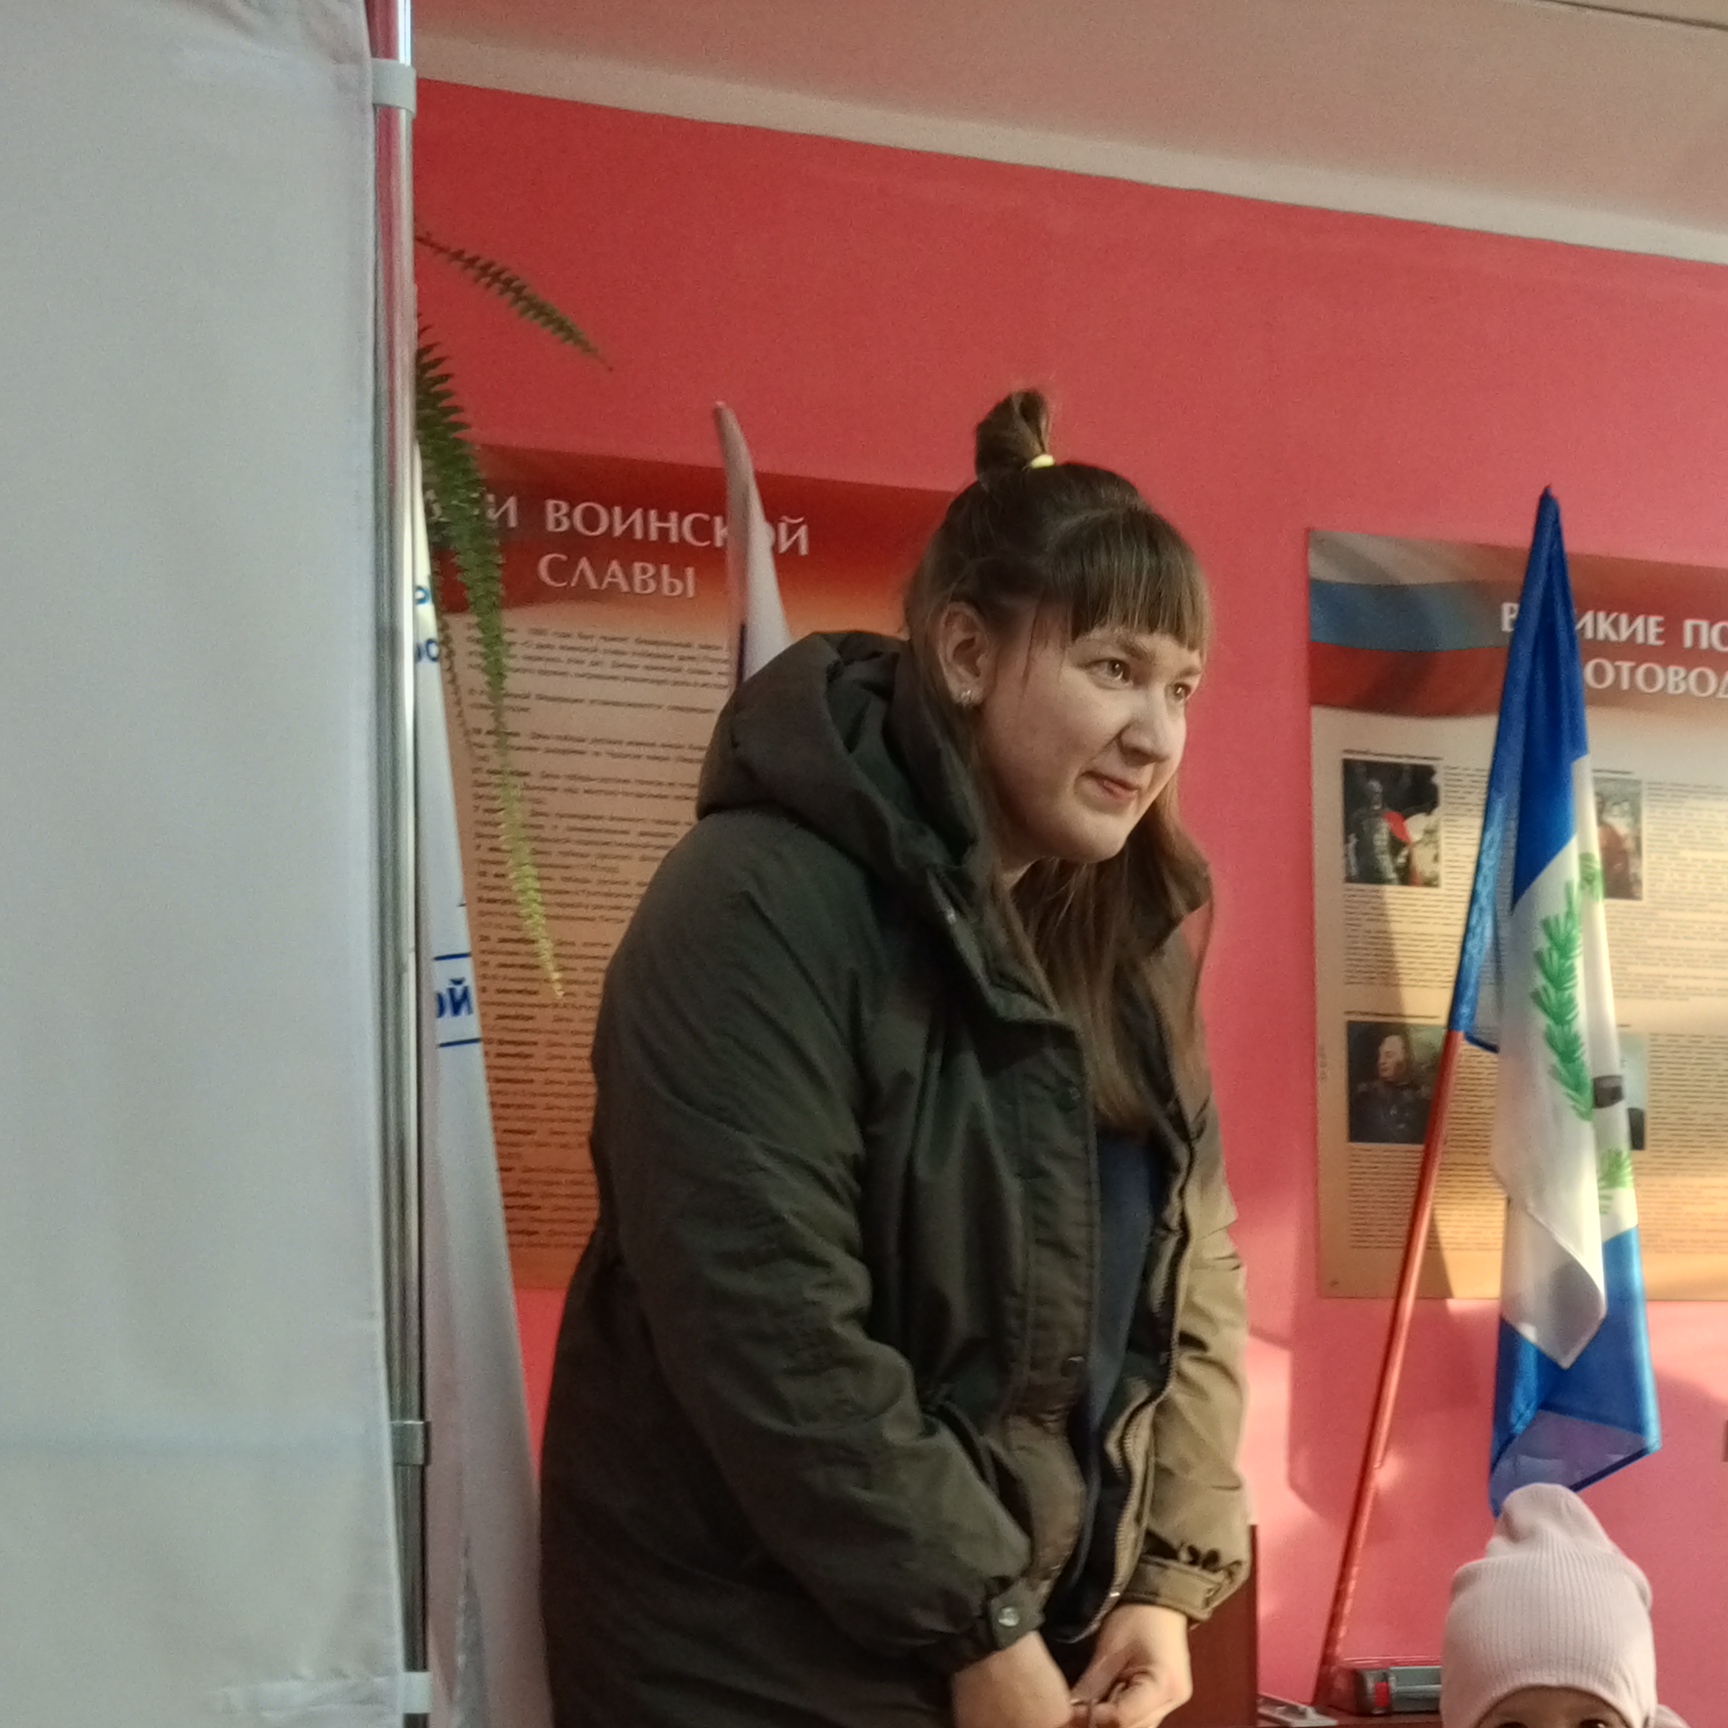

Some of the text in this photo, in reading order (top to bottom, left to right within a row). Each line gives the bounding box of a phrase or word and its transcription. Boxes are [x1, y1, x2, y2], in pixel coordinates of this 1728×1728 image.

[546, 499, 809, 556] ВОИНСКЙ
[537, 553, 695, 598] СЛАВЫ
[1501, 602, 1666, 646] ВИКИЕ
